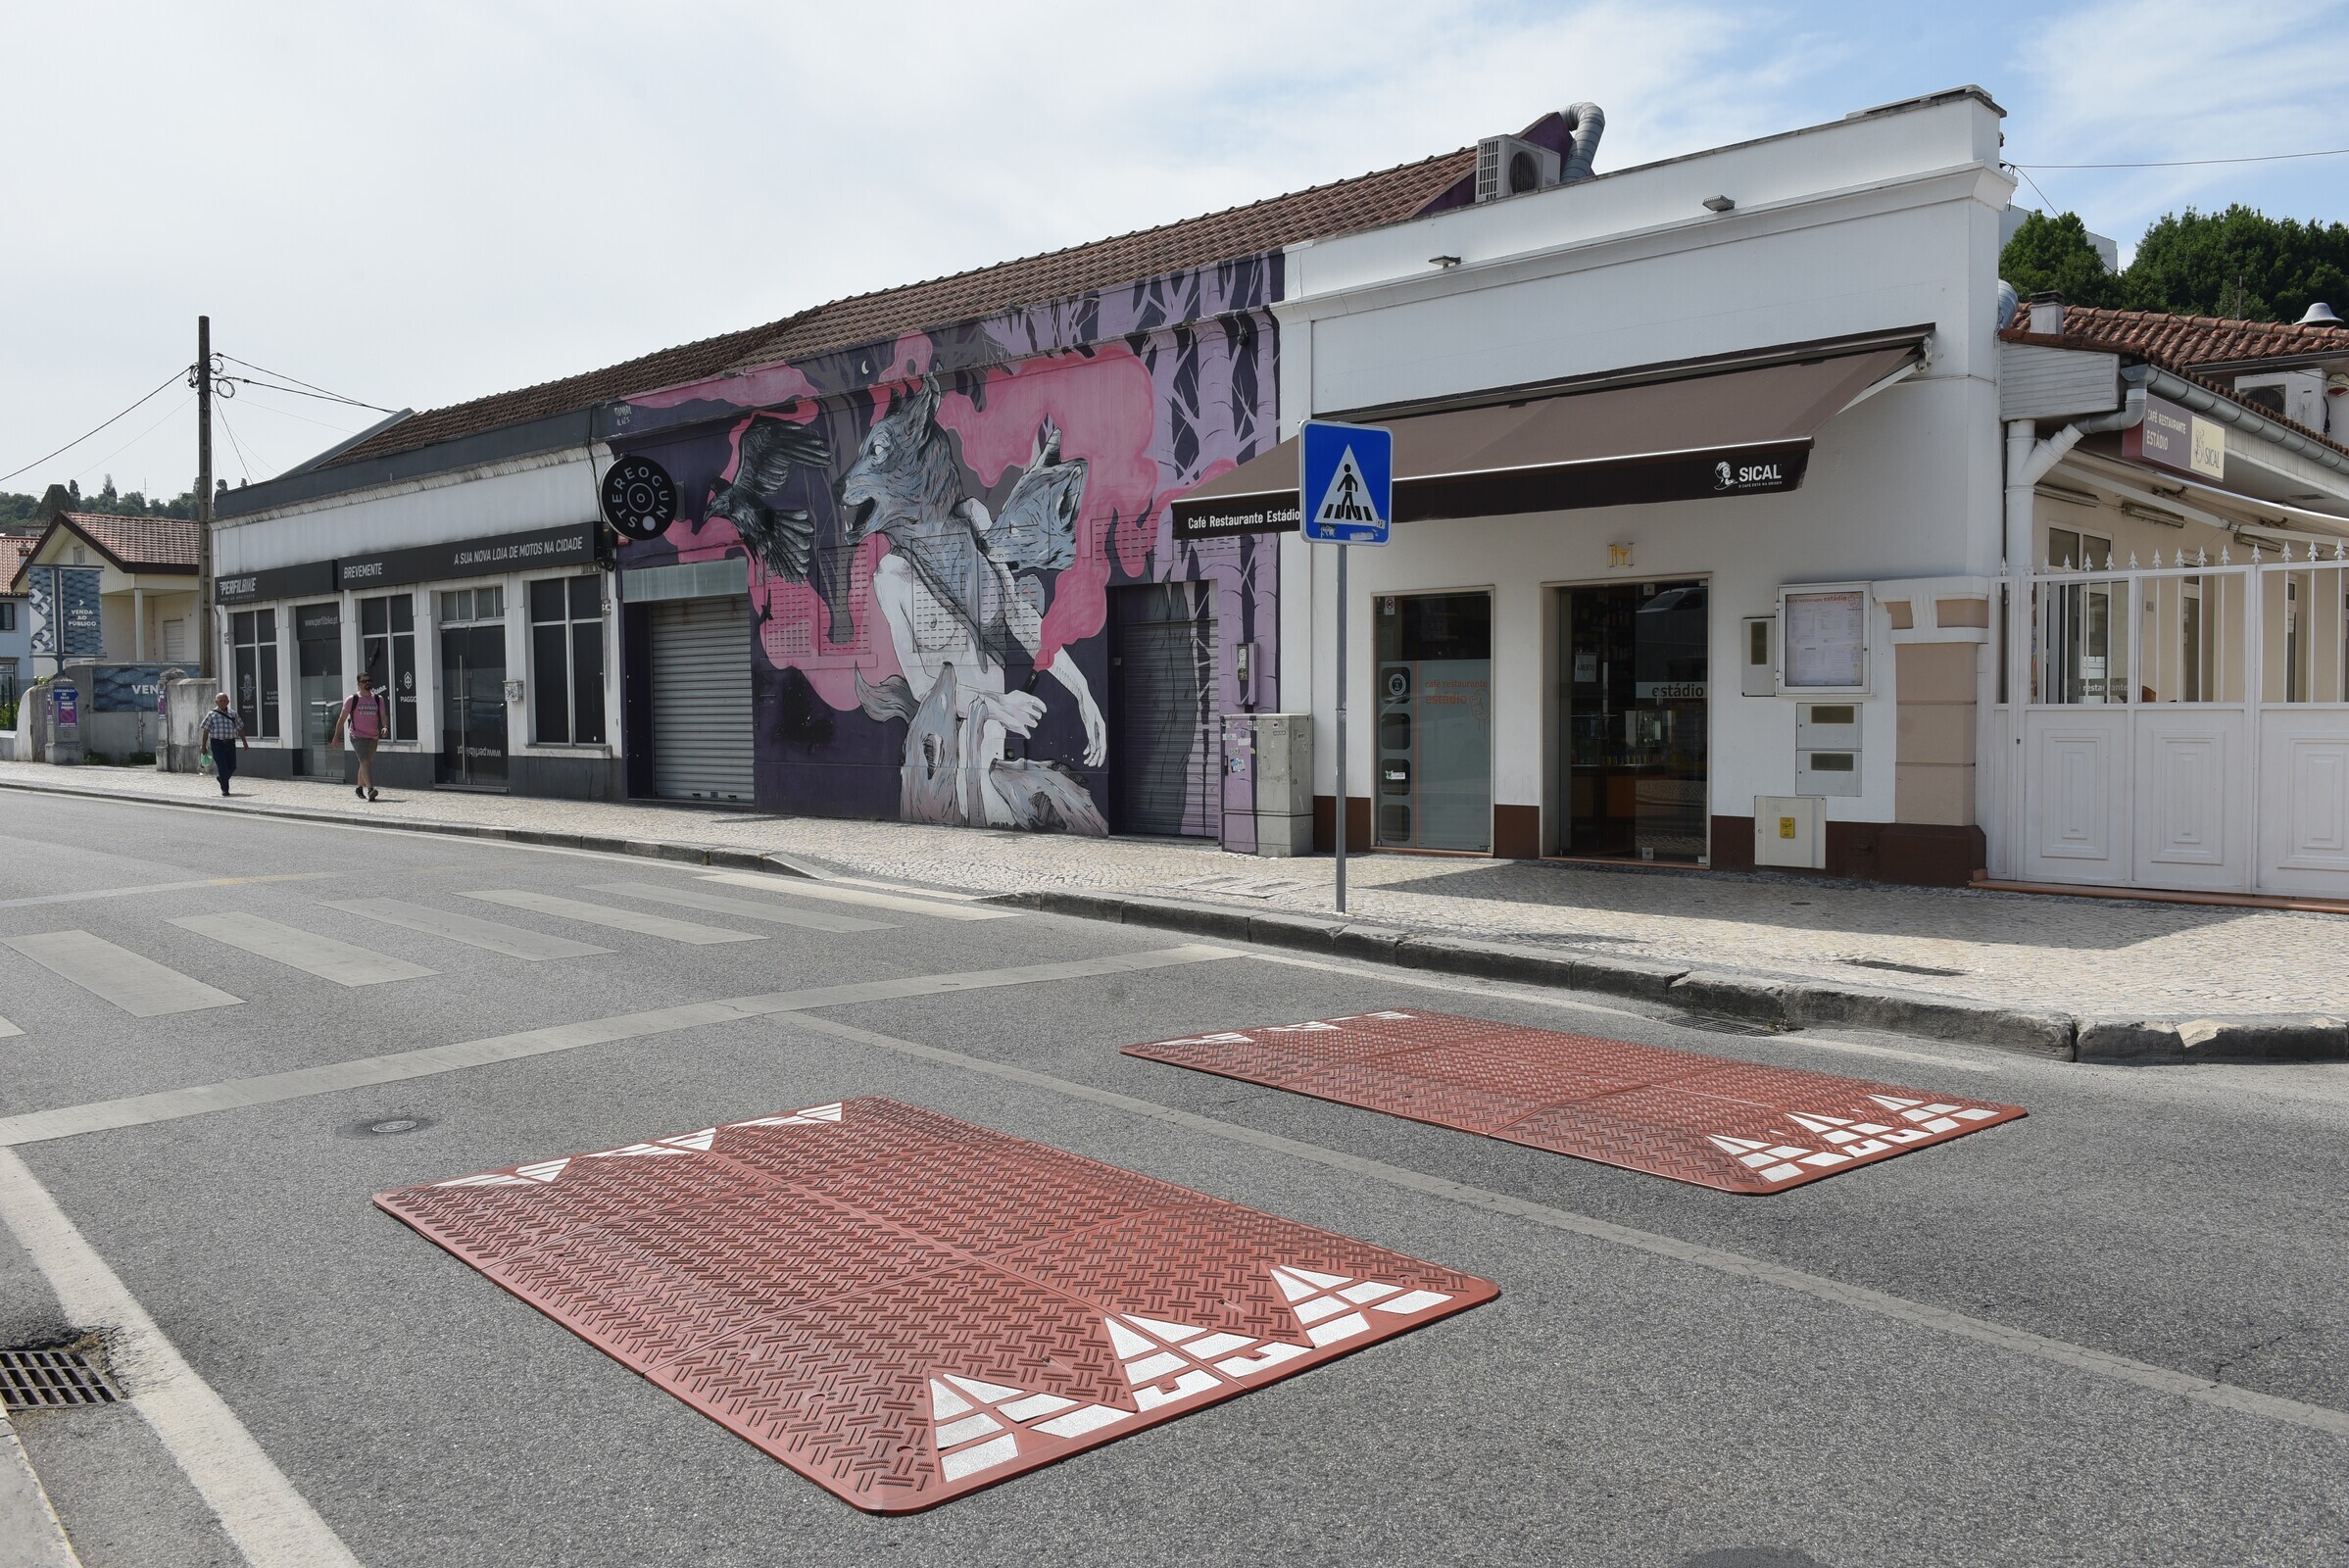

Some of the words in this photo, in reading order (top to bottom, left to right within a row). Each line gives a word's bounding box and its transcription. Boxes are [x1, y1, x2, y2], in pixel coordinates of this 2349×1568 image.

[2147, 409, 2158, 423] CAFÉ
[2159, 413, 2186, 434] RESTAURANTE
[2146, 430, 2169, 451] ESTÁDIO
[2204, 447, 2220, 469] SICAL
[1738, 464, 1783, 482] SICAL
[612, 466, 670, 528] STEREOGUN
[1188, 515, 1206, 529] Café
[1209, 513, 1263, 527] Restaurante
[1266, 508, 1300, 522] Estádio
[454, 553, 460, 565] A
[460, 552, 473, 564] SUA
[473, 549, 491, 563] NOVA
[492, 547, 508, 561] LOJA
[509, 545, 518, 559] DE
[519, 542, 543, 558] MOTOS
[544, 540, 554, 554] NA
[556, 536, 583, 553] CIDADE
[344, 563, 383, 579] BREVEMENTE
[220, 577, 257, 595] PERFILBIKE
[305, 614, 338, 627] www.perfilbike.pt
[131, 684, 159, 695] VEN
[1426, 679, 1441, 688] café
[1443, 679, 1489, 688] restaurante
[1651, 683, 1704, 697] estádio
[1426, 691, 1467, 705] estádio
